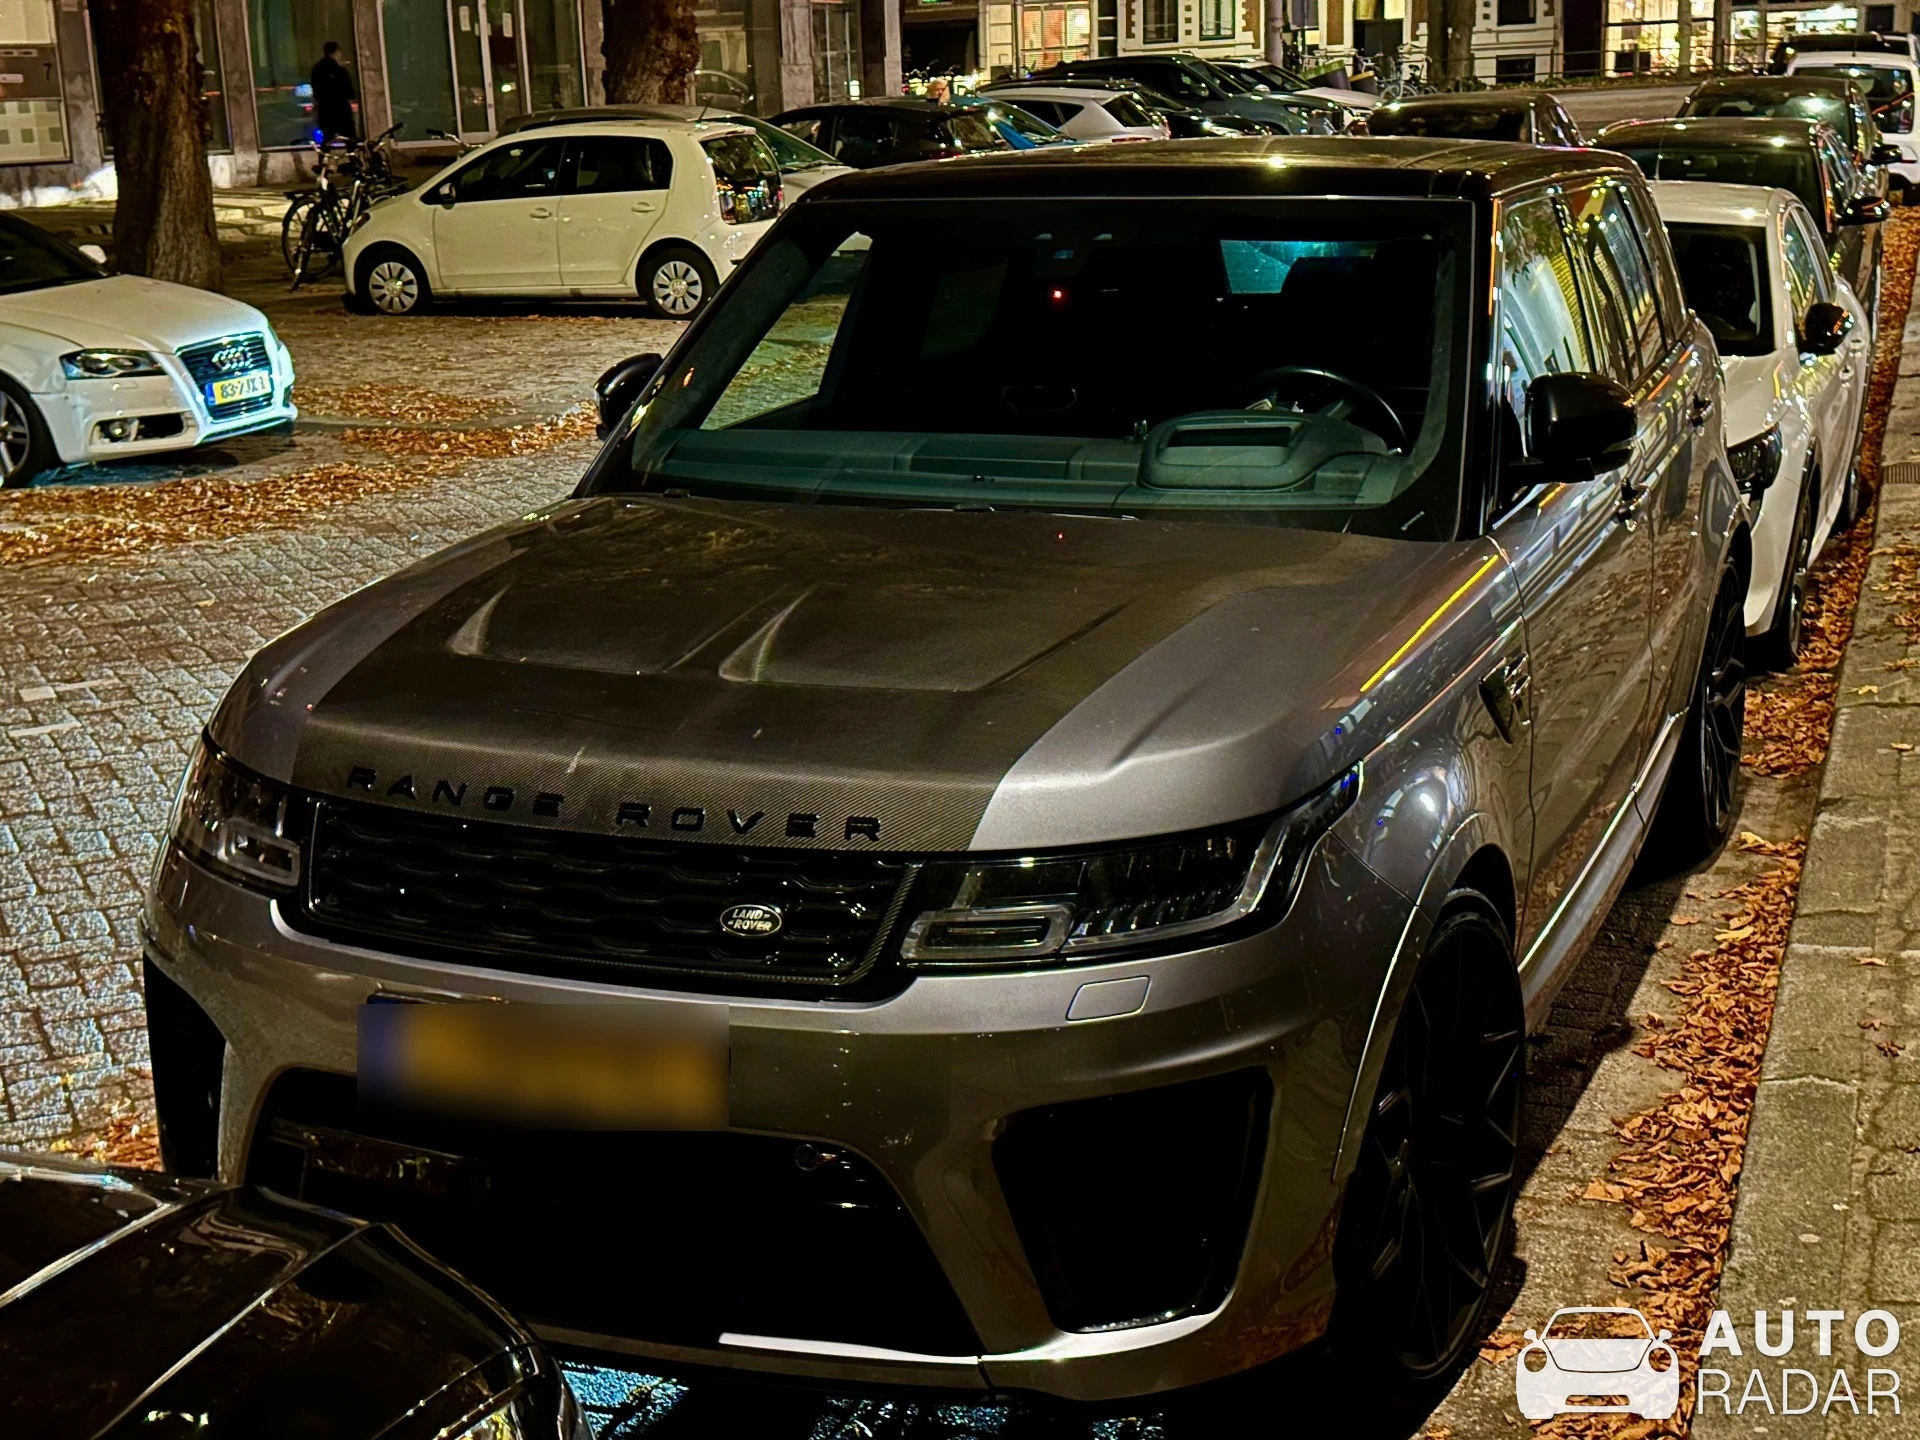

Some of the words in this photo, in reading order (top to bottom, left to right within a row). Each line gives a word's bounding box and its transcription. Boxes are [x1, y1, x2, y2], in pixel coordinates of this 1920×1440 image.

[346, 765, 565, 818] RANGE
[615, 801, 882, 842] ROVER
[732, 908, 764, 920] LAND
[733, 918, 773, 931] ROVER
